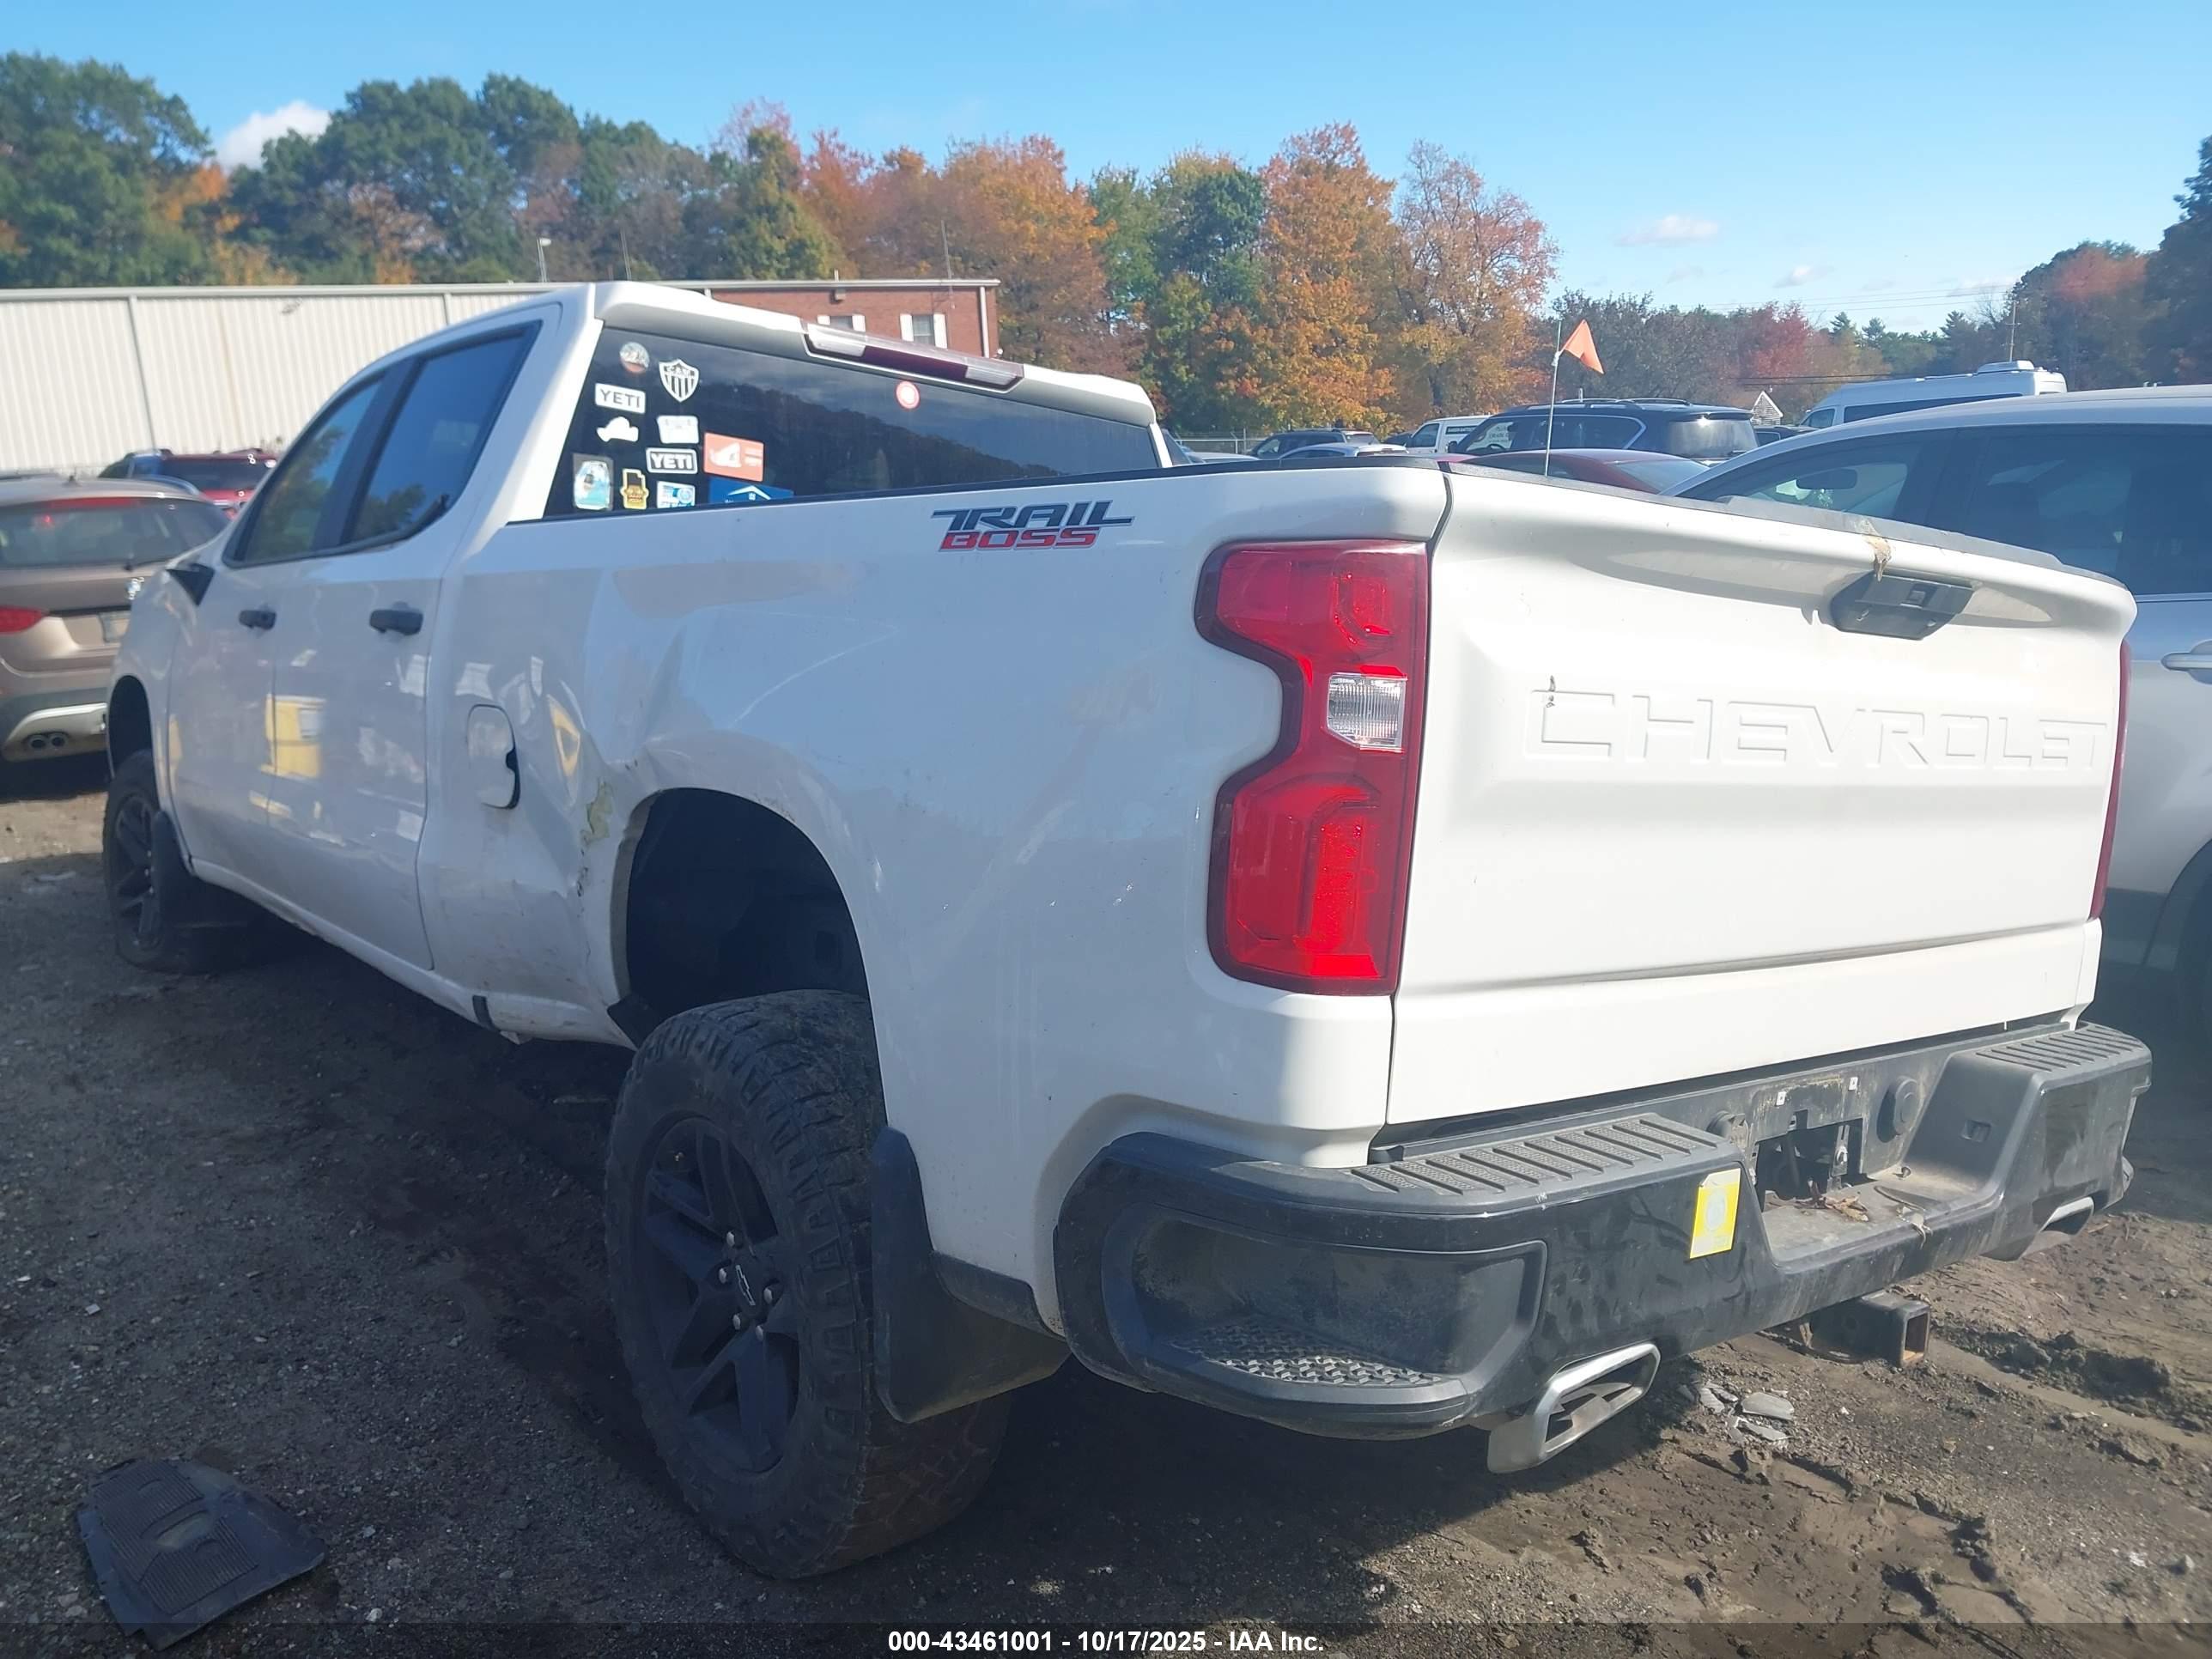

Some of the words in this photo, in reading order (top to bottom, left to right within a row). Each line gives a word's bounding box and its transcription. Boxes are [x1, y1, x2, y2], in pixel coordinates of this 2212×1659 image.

[599, 388, 641, 409] YETI
[650, 453, 692, 470] YETI
[931, 500, 1134, 531] TRAIL
[939, 526, 1101, 551] BOSS
[1525, 689, 2107, 770] CHEVROLET
